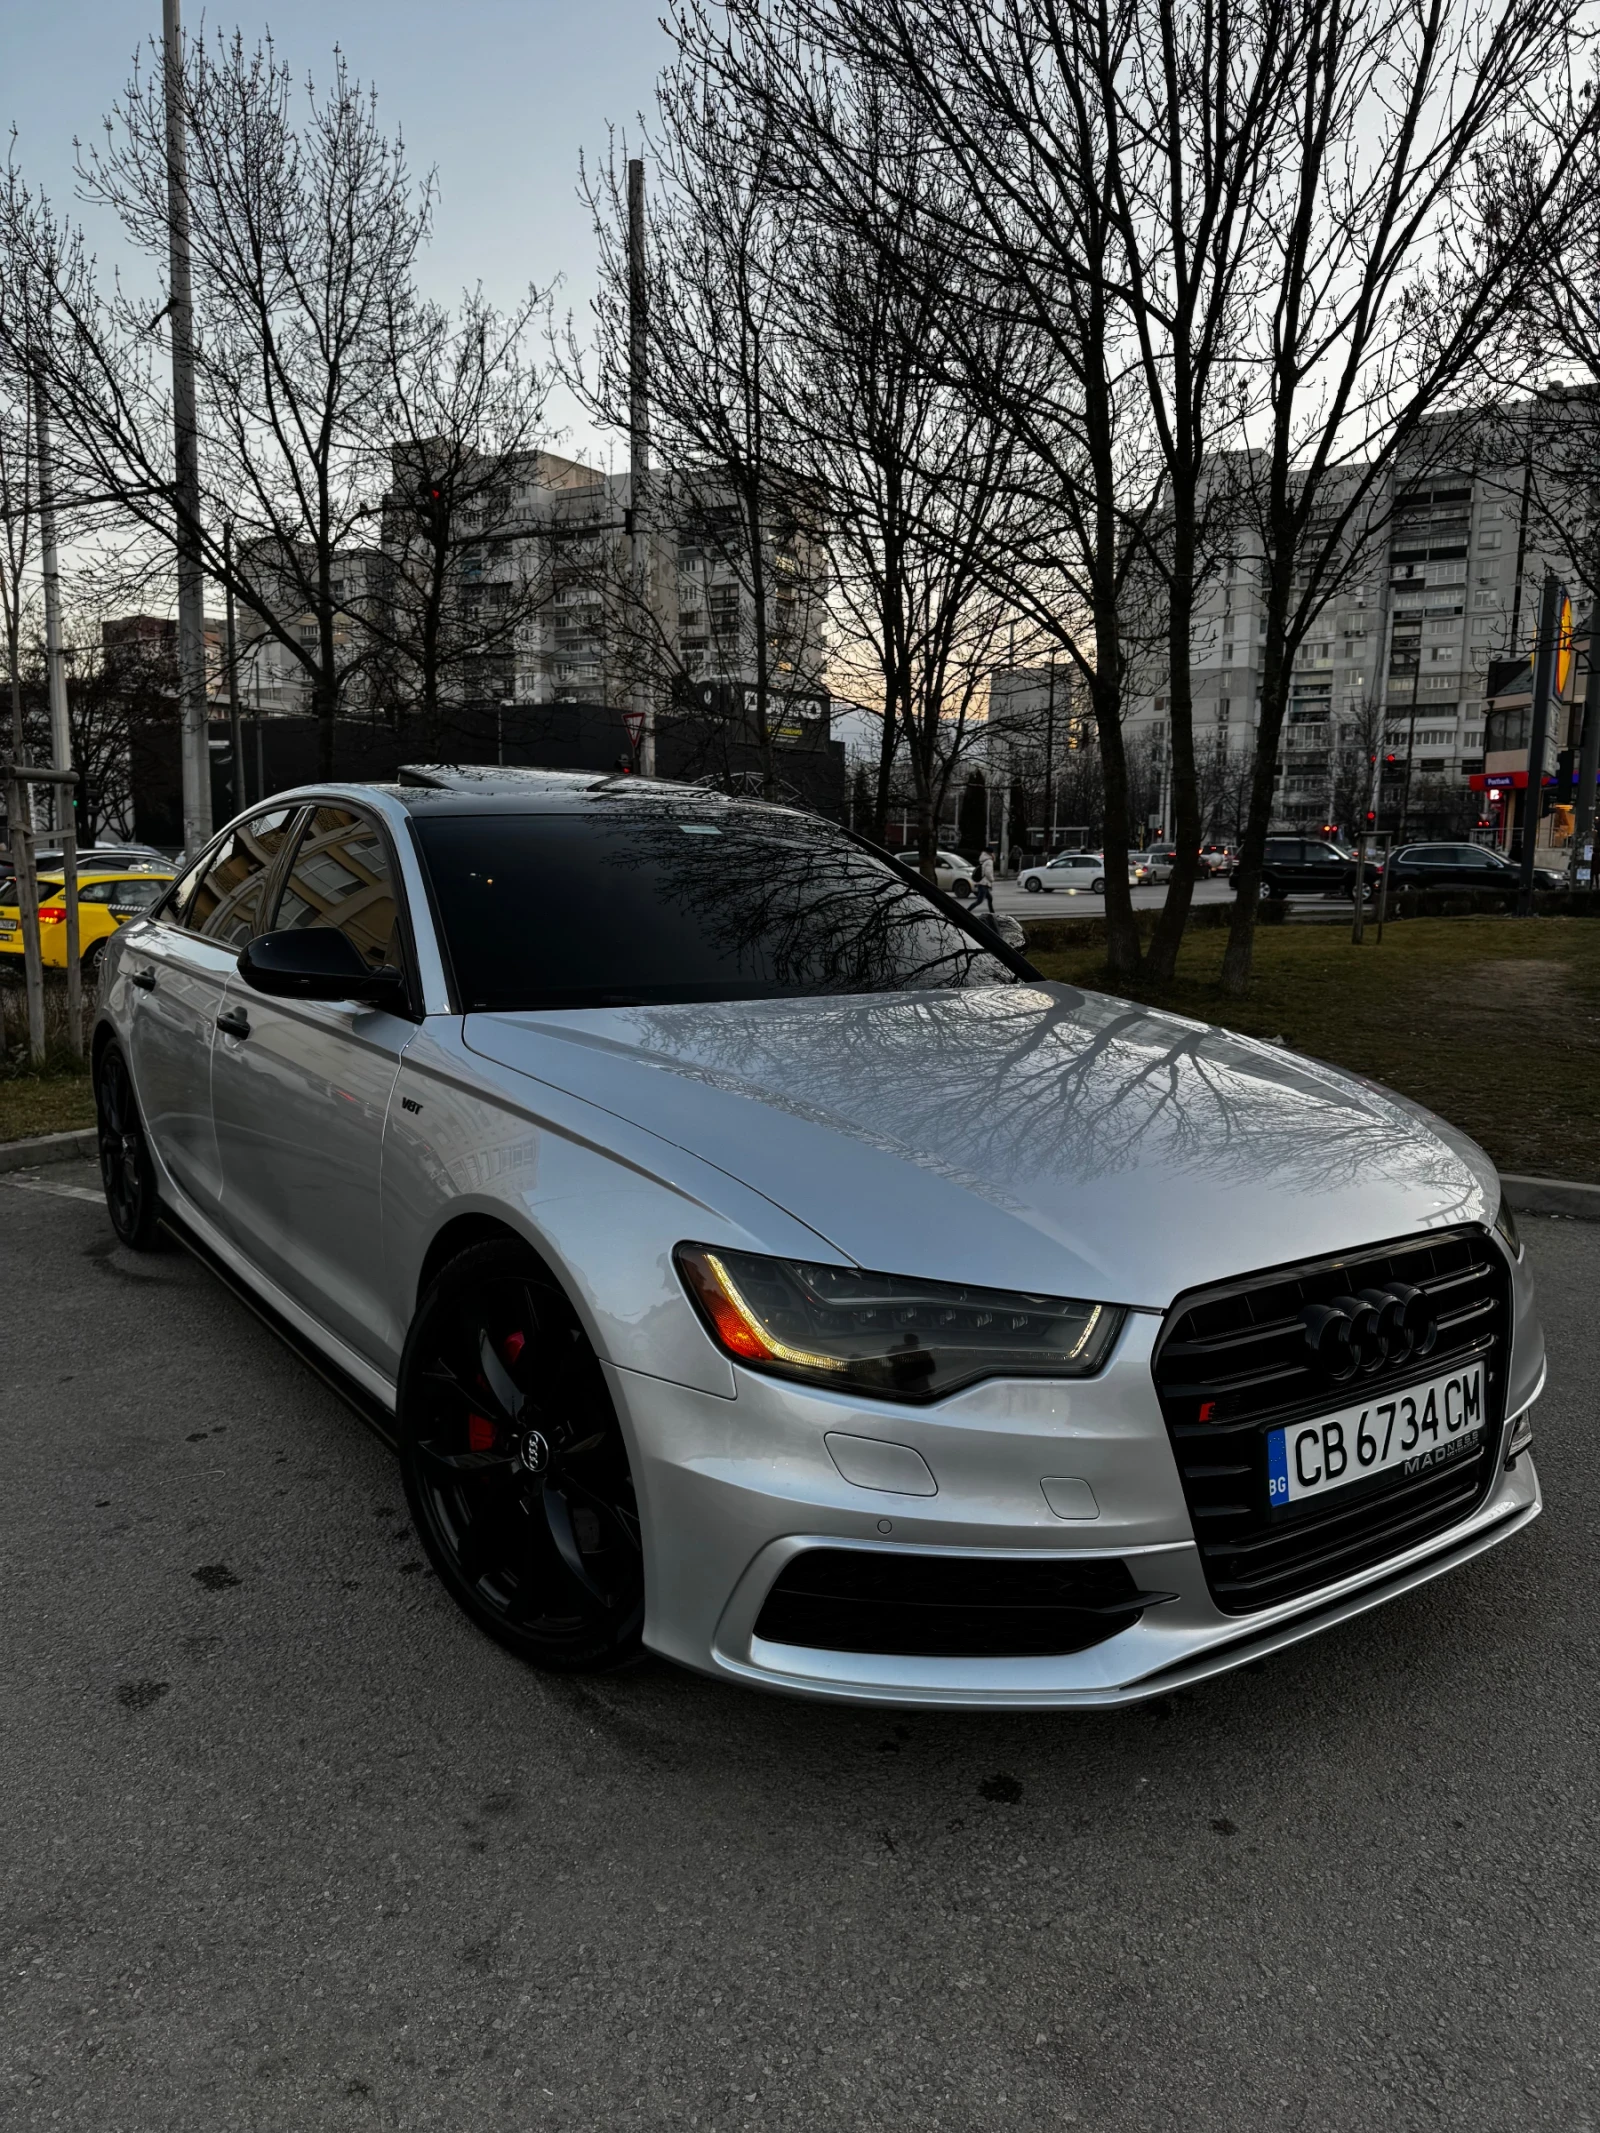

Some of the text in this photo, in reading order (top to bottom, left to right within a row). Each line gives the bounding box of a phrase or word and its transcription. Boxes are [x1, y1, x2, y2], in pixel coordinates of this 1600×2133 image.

[1487, 777, 1510, 786] Postbank
[1295, 1369, 1481, 1488] CB 6734 CM
[1269, 1478, 1287, 1496] BG
